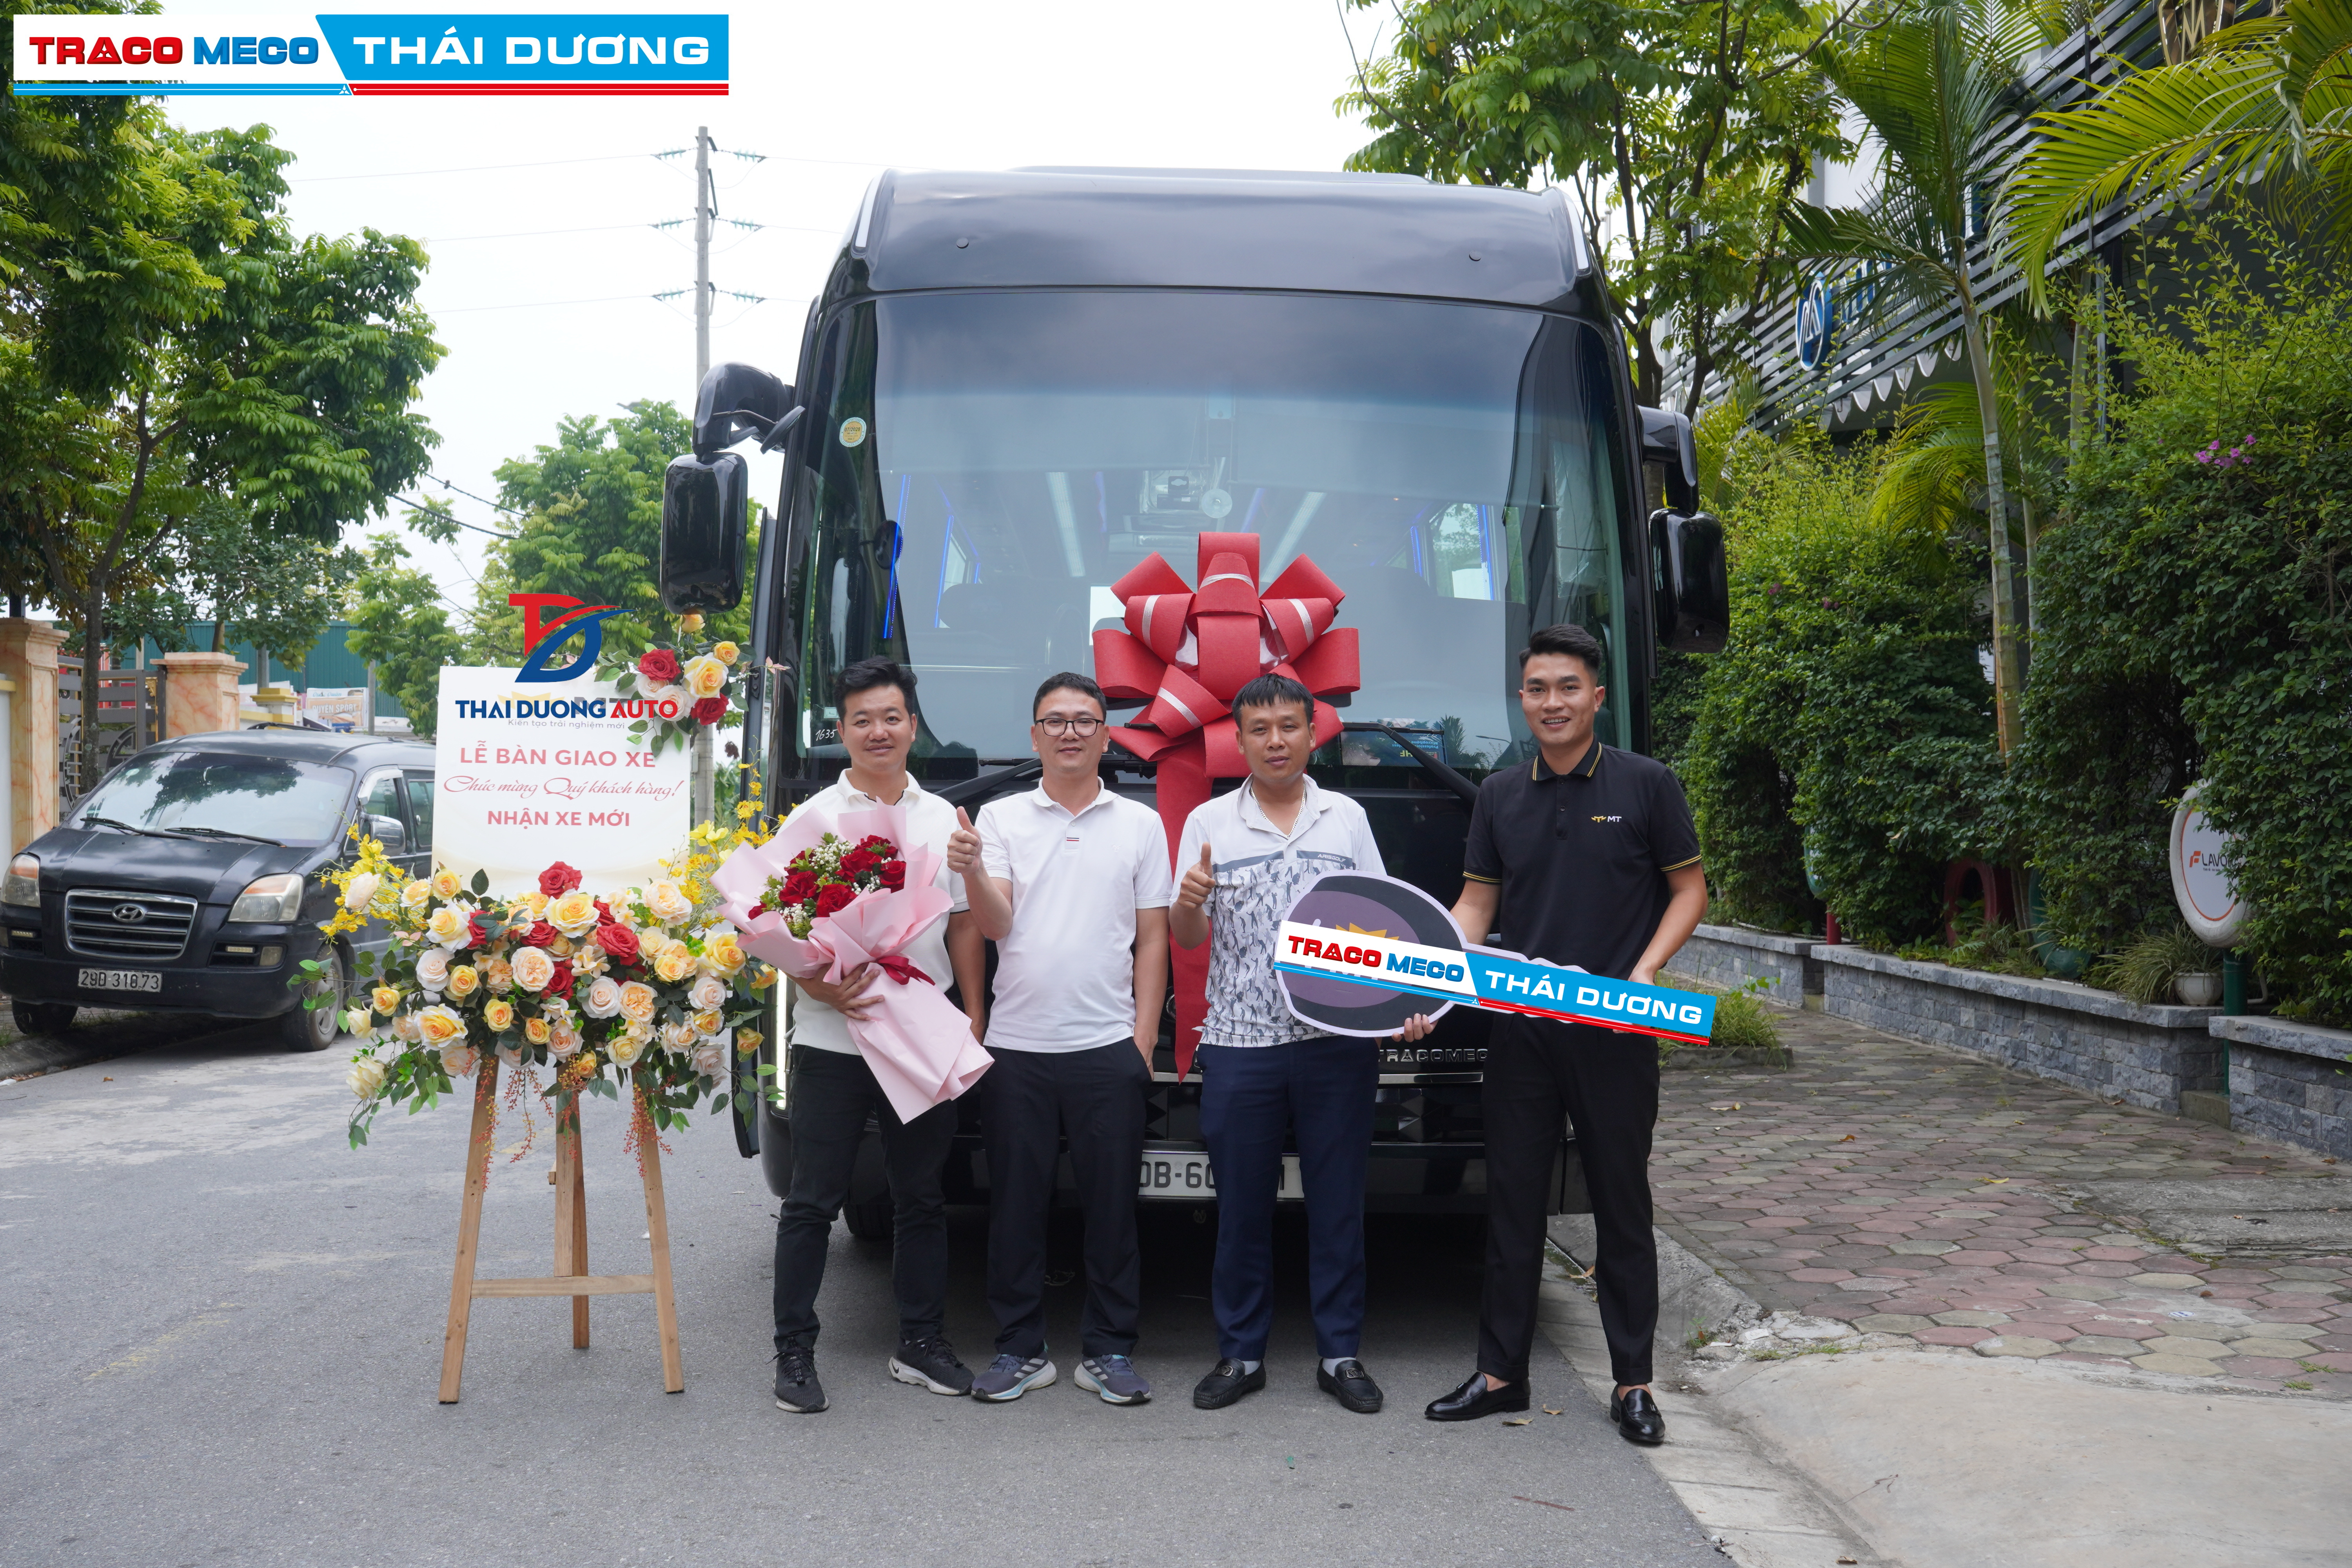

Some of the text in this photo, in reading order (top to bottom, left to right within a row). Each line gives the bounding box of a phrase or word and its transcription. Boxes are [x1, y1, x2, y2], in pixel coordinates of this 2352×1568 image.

[532, 720, 547, 728] tạo
[569, 720, 604, 730] nghiệm
[460, 740, 655, 768] LỄ BÀN GIAO XE
[444, 775, 685, 801] Chúc mừng Quý khách hàng!
[488, 808, 630, 829] NHẬN XE MỚI
[1318, 854, 1346, 862] ARISGOLF
